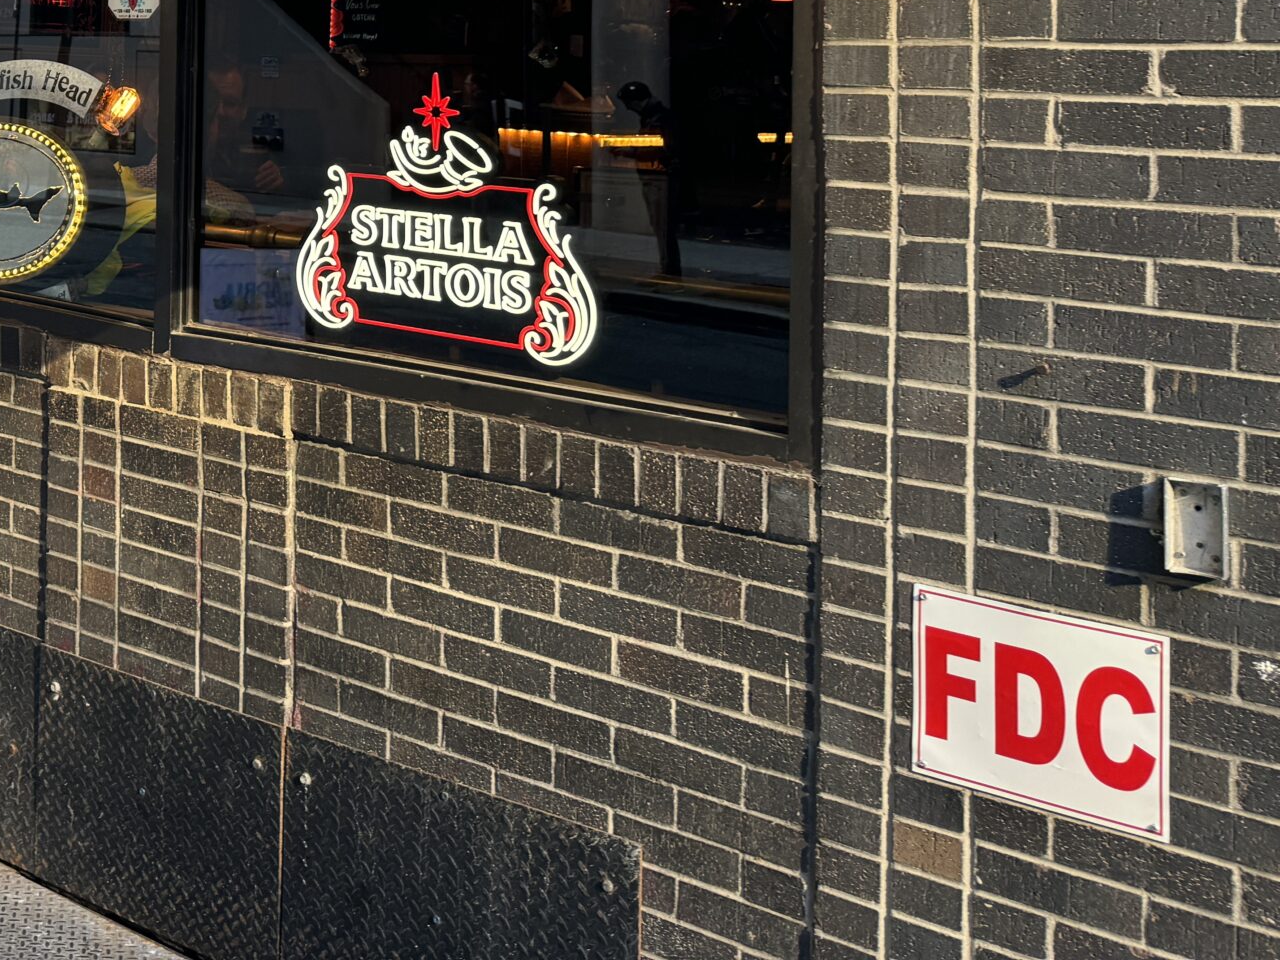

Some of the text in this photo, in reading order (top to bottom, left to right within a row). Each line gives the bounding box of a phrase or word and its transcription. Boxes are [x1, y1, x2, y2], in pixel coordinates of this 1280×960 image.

[41, 68, 93, 108] Head
[350, 204, 536, 266] STELLA
[346, 250, 533, 315] ARTOIS
[924, 625, 1156, 792] FDC
